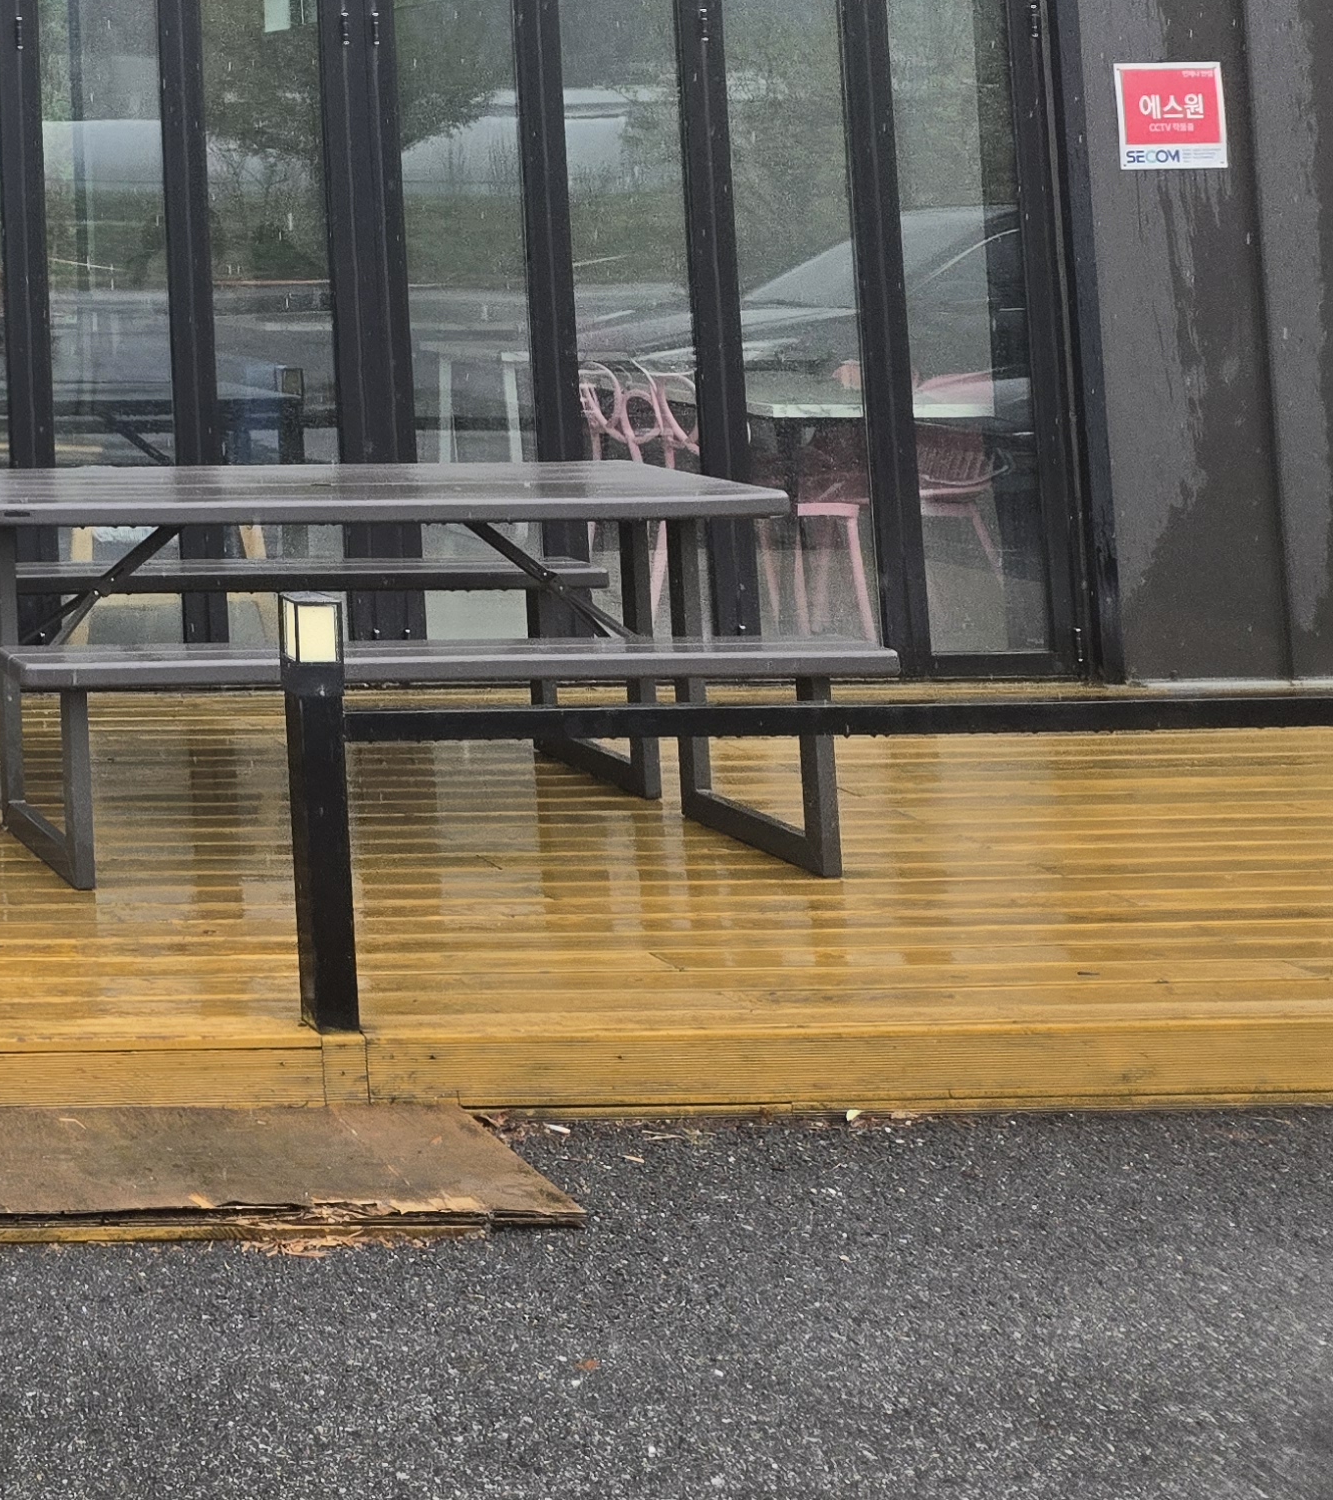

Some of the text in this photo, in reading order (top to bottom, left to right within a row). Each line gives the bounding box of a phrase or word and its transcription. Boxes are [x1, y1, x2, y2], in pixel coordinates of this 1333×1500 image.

[1138, 93, 1205, 119] 에스원
[1149, 122, 1171, 132] CCTV
[1126, 149, 1181, 164] SECOM
